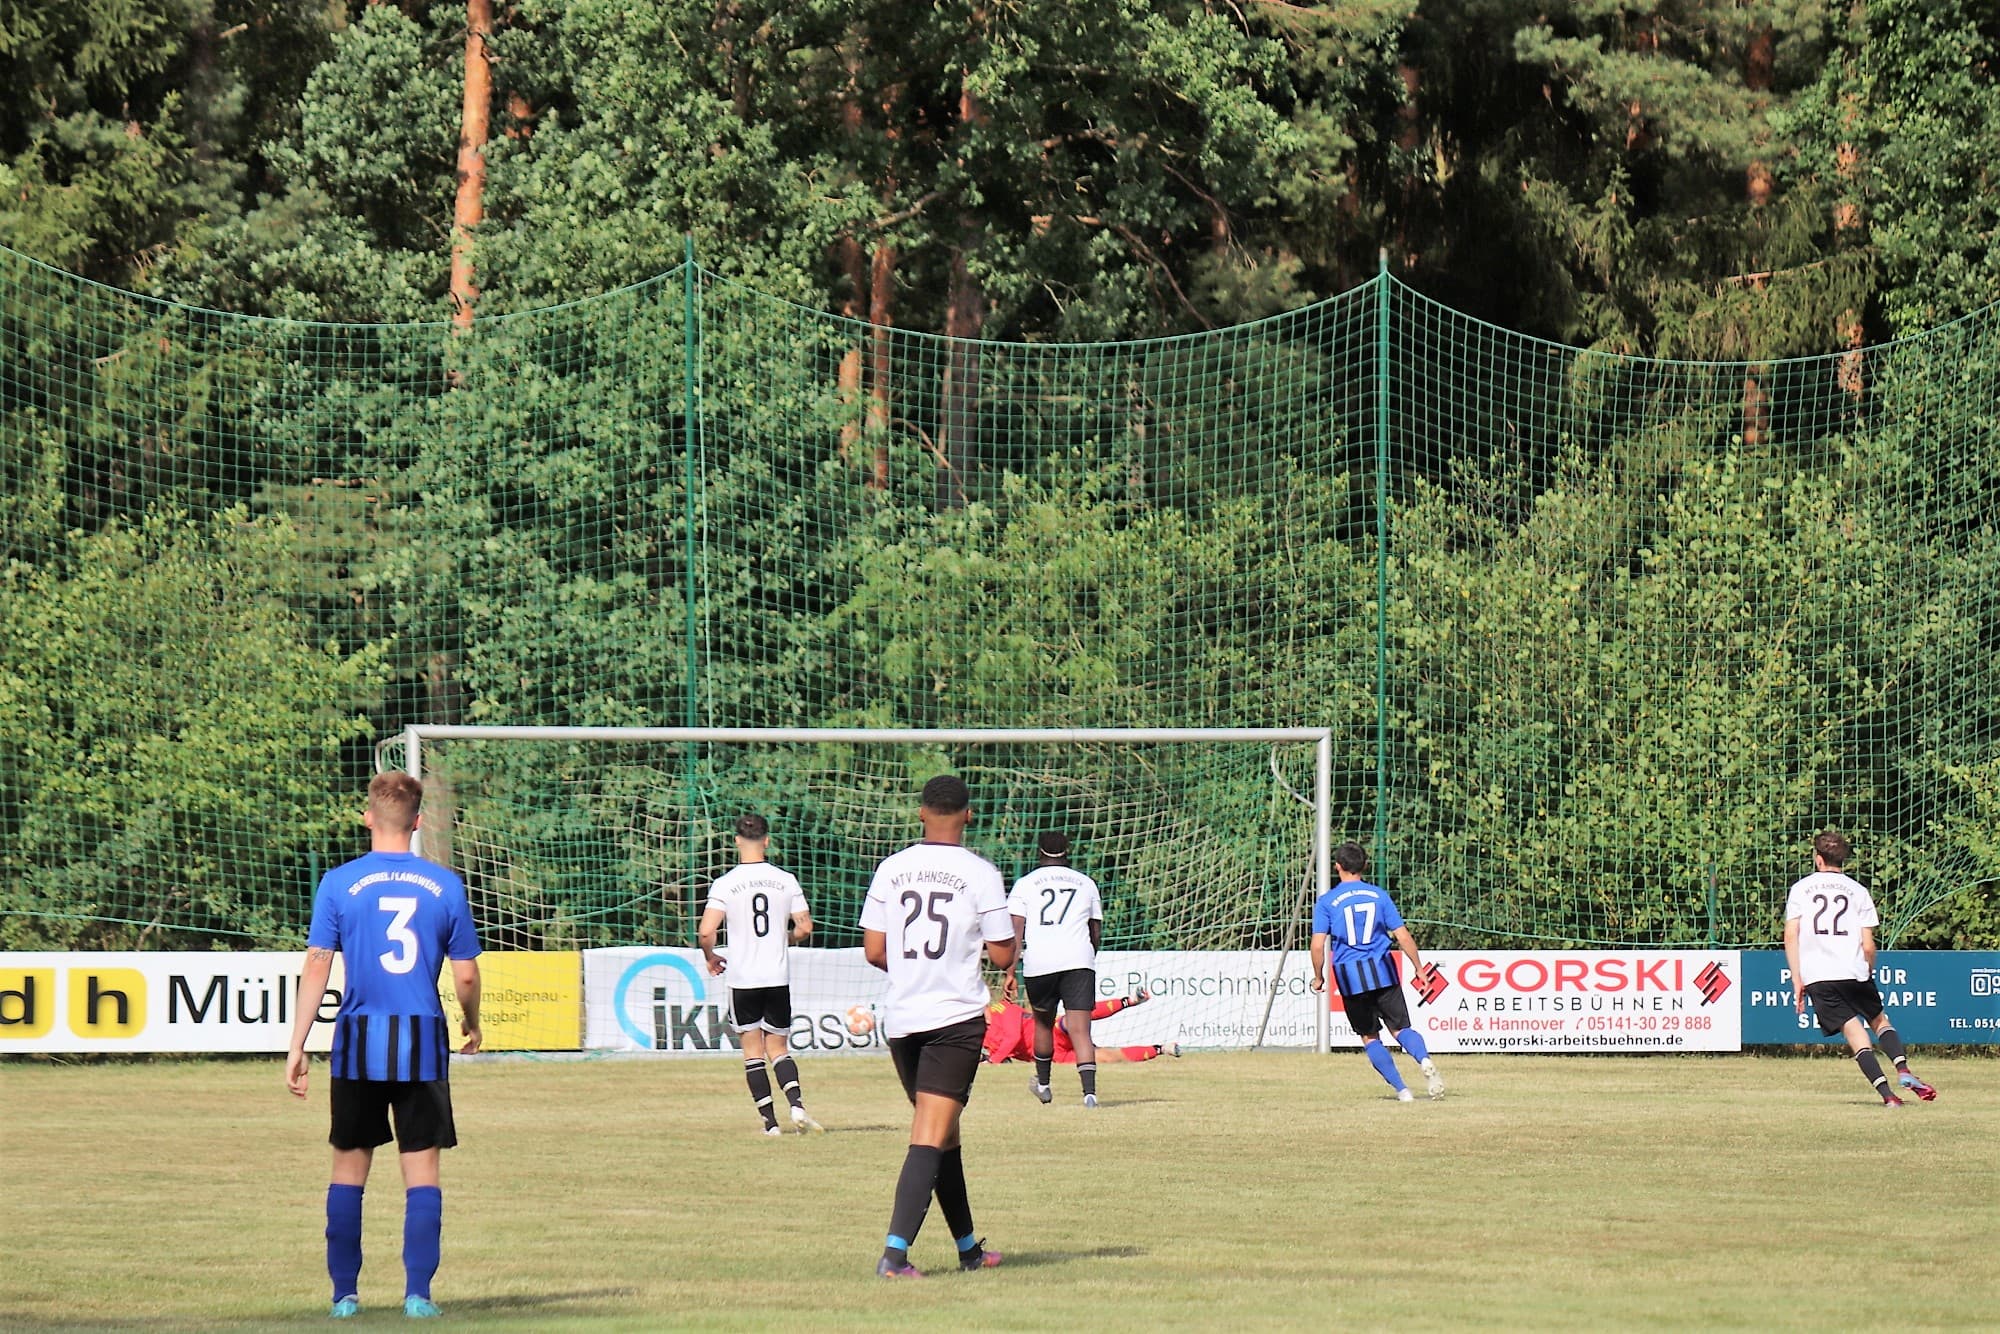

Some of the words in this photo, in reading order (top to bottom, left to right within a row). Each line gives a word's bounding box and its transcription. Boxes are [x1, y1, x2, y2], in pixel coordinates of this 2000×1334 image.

[890, 872, 912, 889] MTV
[916, 870, 968, 895] AHNSBECK
[752, 893, 769, 937] 8
[1040, 888, 1077, 925] 27
[1812, 894, 1849, 936] 22
[378, 896, 419, 974] 3
[900, 890, 954, 960] 25
[1343, 902, 1376, 946] 17
[1457, 959, 1683, 992] GORSKI
[1458, 994, 1684, 1011] ARBEITSBÜHNEN
[1178, 1023, 1262, 1037] Architekten
[1269, 1022, 1297, 1037] und
[1428, 1016, 1468, 1031] Celle
[1473, 1016, 1484, 1031] &
[1489, 1016, 1565, 1031] Hannover
[1587, 1015, 1657, 1031] 05141-30
[1661, 1015, 1680, 1030] 29
[1684, 1015, 1712, 1030] 888
[1949, 1018, 1972, 1029] TEL.
[1457, 1034, 1683, 1049] www.gorski-arbeitsbuehnen.de
